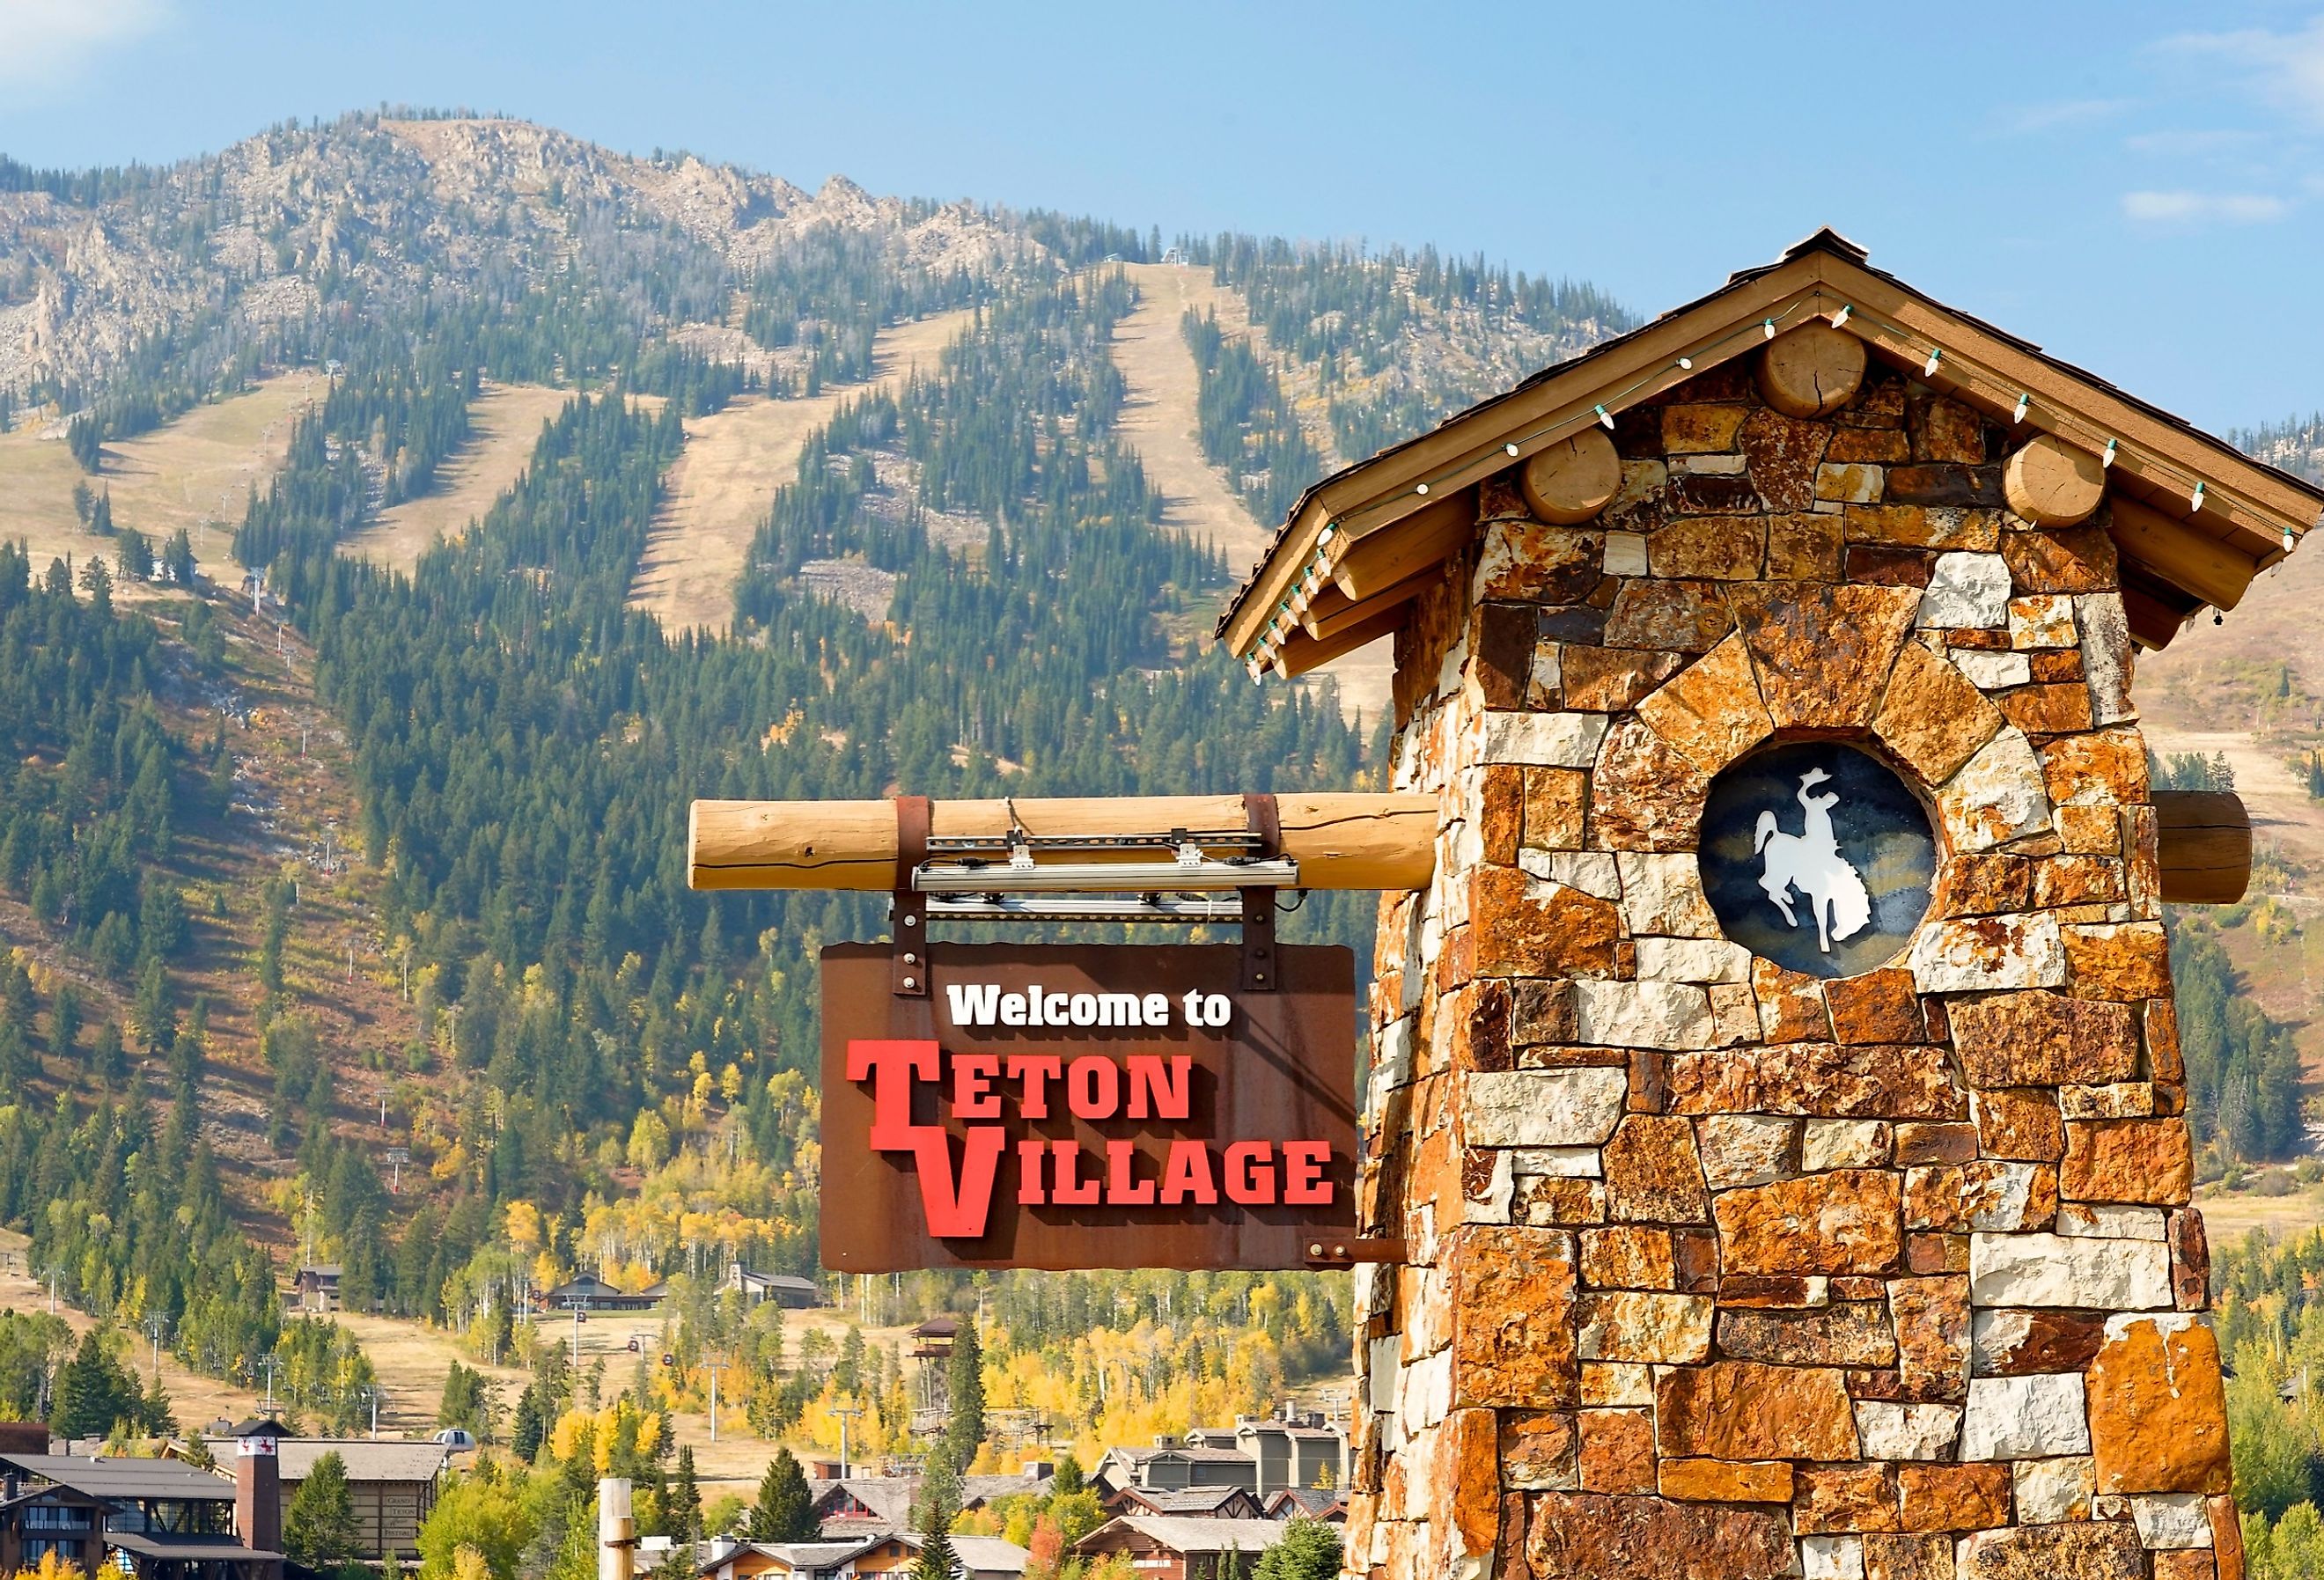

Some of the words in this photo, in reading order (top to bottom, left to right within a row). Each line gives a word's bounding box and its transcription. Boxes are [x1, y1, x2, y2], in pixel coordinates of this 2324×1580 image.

[946, 984, 1169, 1026] Welcome
[1182, 988, 1231, 1026] to
[846, 1040, 1192, 1150] TETON
[914, 1126, 1334, 1238] VILLAGE
